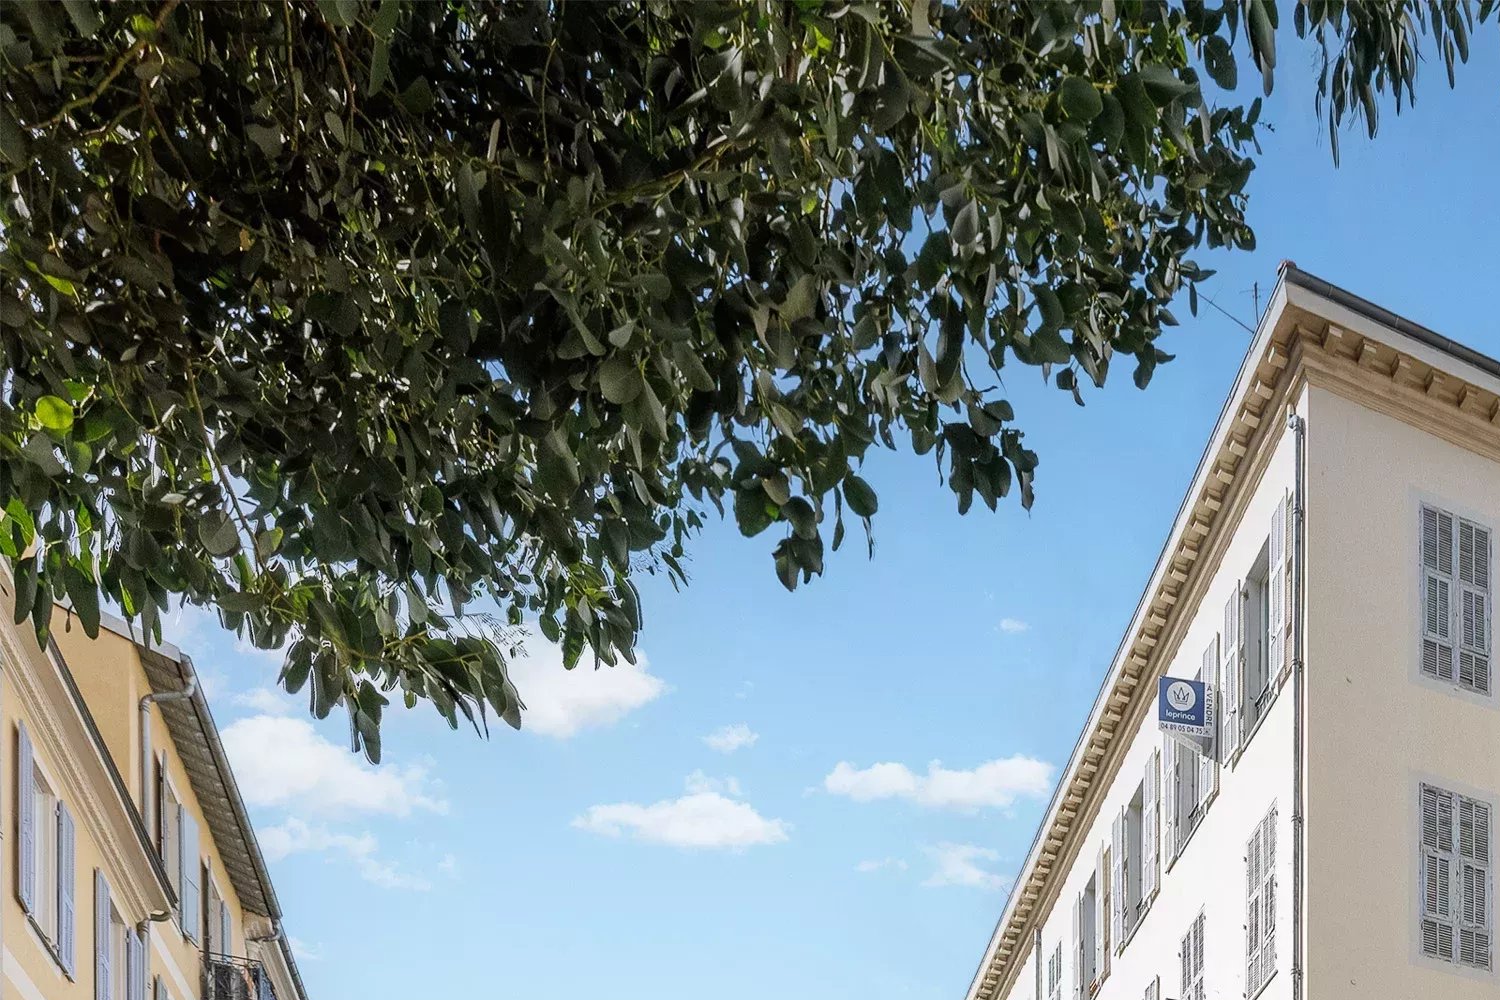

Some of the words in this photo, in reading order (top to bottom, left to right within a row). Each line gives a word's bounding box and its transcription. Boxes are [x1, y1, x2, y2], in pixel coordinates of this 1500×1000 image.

[1165, 709, 1196, 721] leprince
[1160, 722, 1168, 730] 04
[1177, 724, 1186, 732] 05
